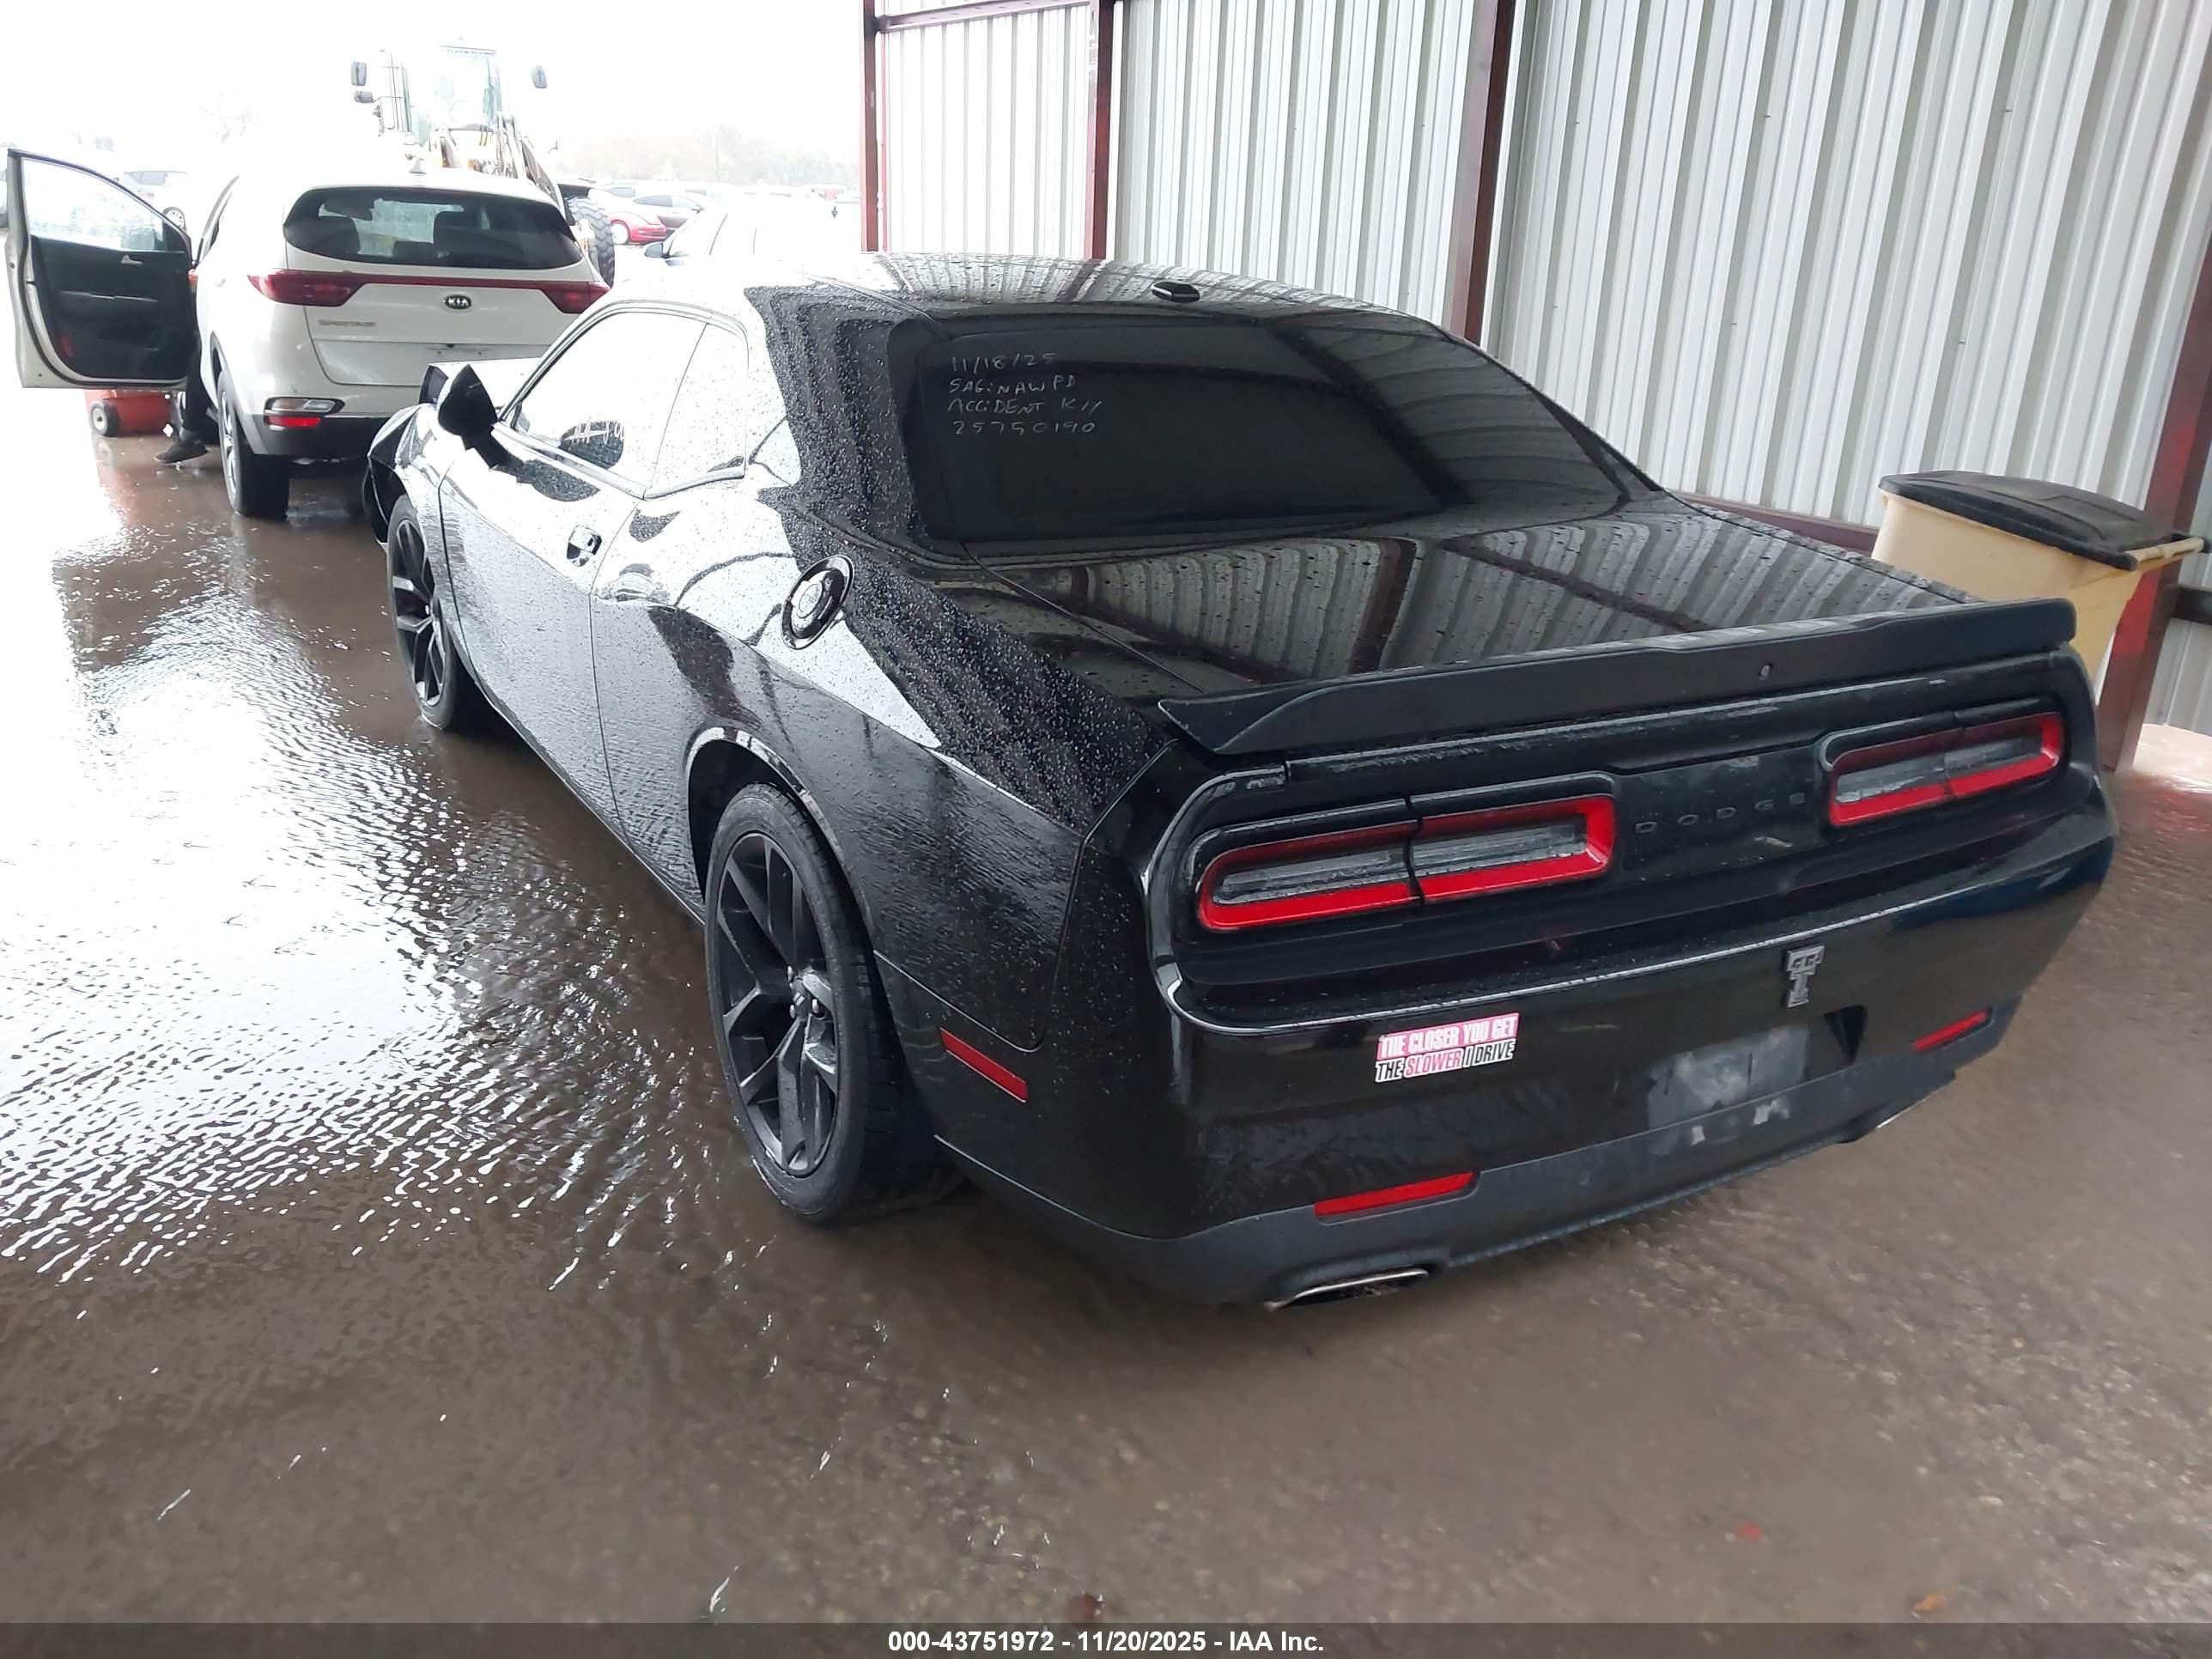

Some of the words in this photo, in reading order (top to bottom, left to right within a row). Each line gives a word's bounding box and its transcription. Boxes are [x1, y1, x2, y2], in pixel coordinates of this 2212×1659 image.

[951, 353, 1058, 374] 11/18/25
[1053, 374, 1076, 390] PD
[952, 420, 1096, 435] 25750190
[1635, 792, 1806, 834] DODGE
[1380, 1035, 1407, 1058] THE
[1407, 1026, 1460, 1054] CLOSER
[1462, 1020, 1490, 1043] YOU
[1491, 1016, 1517, 1039] GET
[1376, 1060, 1404, 1082] THE
[1405, 1050, 1463, 1077] SLOWER
[1474, 1040, 1516, 1065] DRIVE
